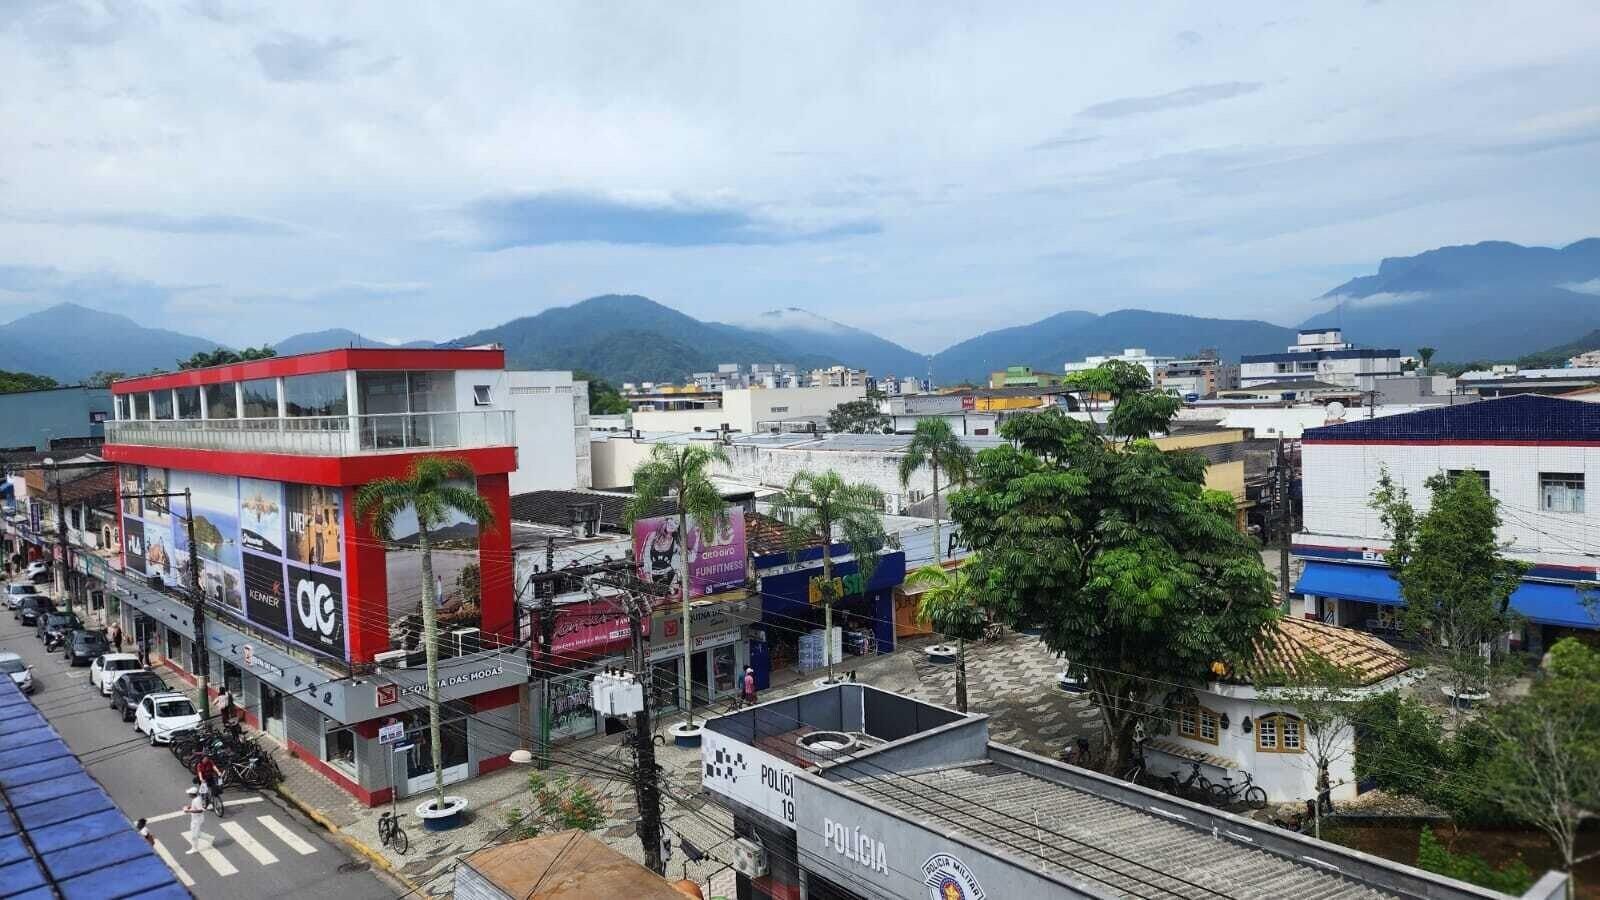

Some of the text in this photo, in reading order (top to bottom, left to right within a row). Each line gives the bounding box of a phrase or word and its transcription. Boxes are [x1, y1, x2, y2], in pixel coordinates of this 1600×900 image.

[695, 560, 744, 577] FUNFITNESS
[249, 588, 280, 608] KENNER
[401, 666, 503, 696] ESQUA DAS MODAS
[782, 798, 797, 823] 19
[824, 817, 889, 876] POLÍCIA
[953, 862, 980, 896] MILITAR
